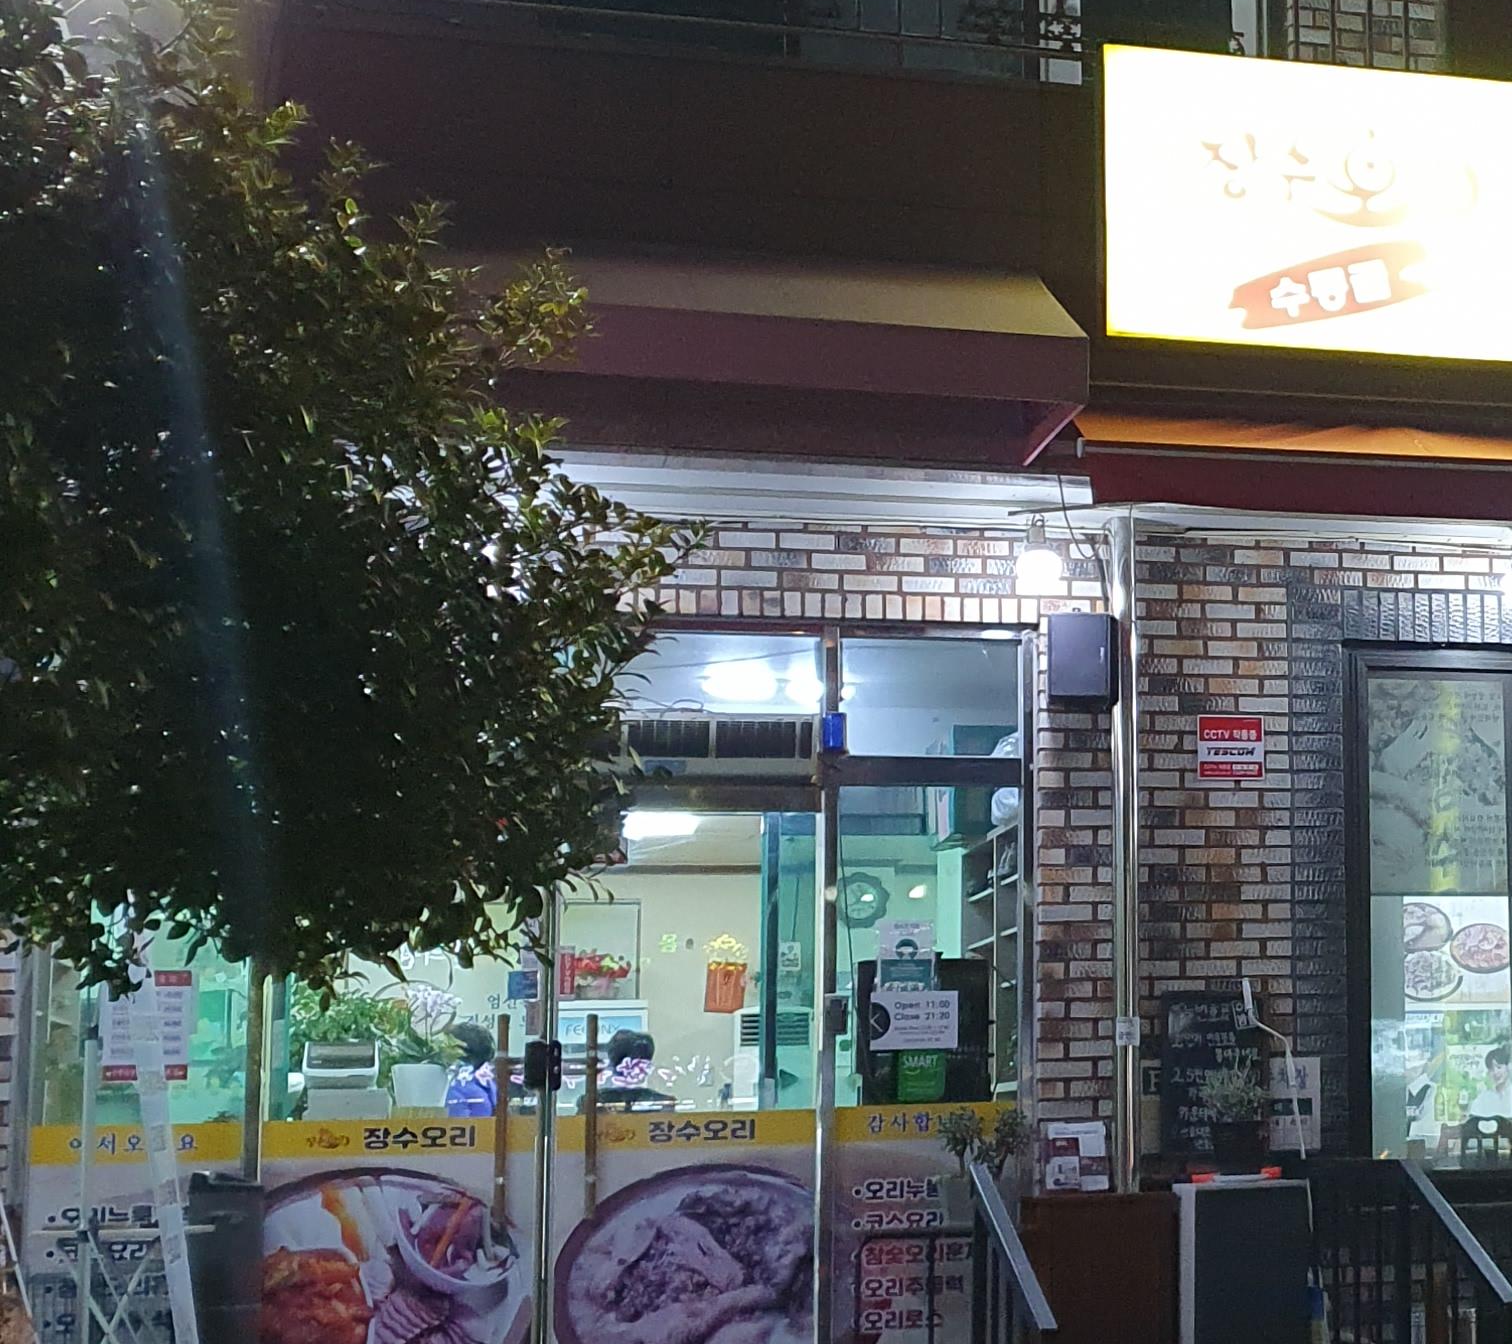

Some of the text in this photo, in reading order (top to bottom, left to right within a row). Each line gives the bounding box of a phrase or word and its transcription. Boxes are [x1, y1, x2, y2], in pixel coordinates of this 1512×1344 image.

[1203, 729, 1230, 739] CCTV
[894, 1001, 921, 1010] Open
[894, 1012, 920, 1021] Close
[649, 1119, 756, 1143] 장수오리
[364, 1126, 476, 1150] 장수오리
